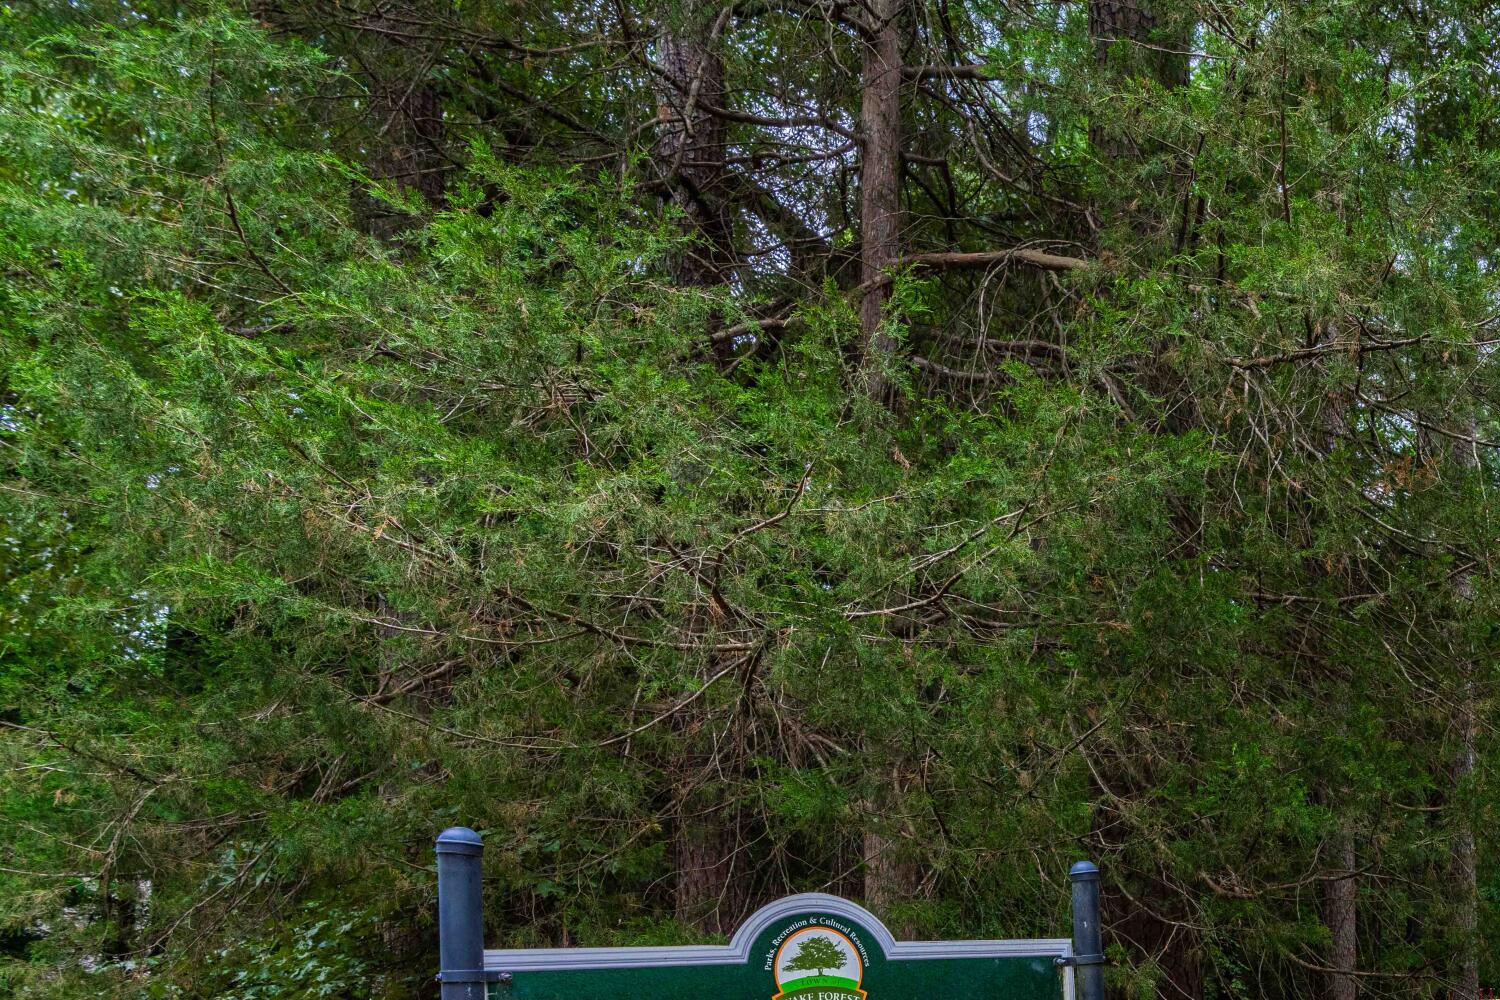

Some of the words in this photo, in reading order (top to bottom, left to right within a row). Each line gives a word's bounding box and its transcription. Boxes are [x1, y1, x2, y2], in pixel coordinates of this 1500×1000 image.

[764, 946, 777, 971] Parks,
[772, 919, 807, 946] Recreation
[809, 916, 817, 924] &
[819, 917, 851, 934] Cultural
[850, 931, 869, 967] Resources
